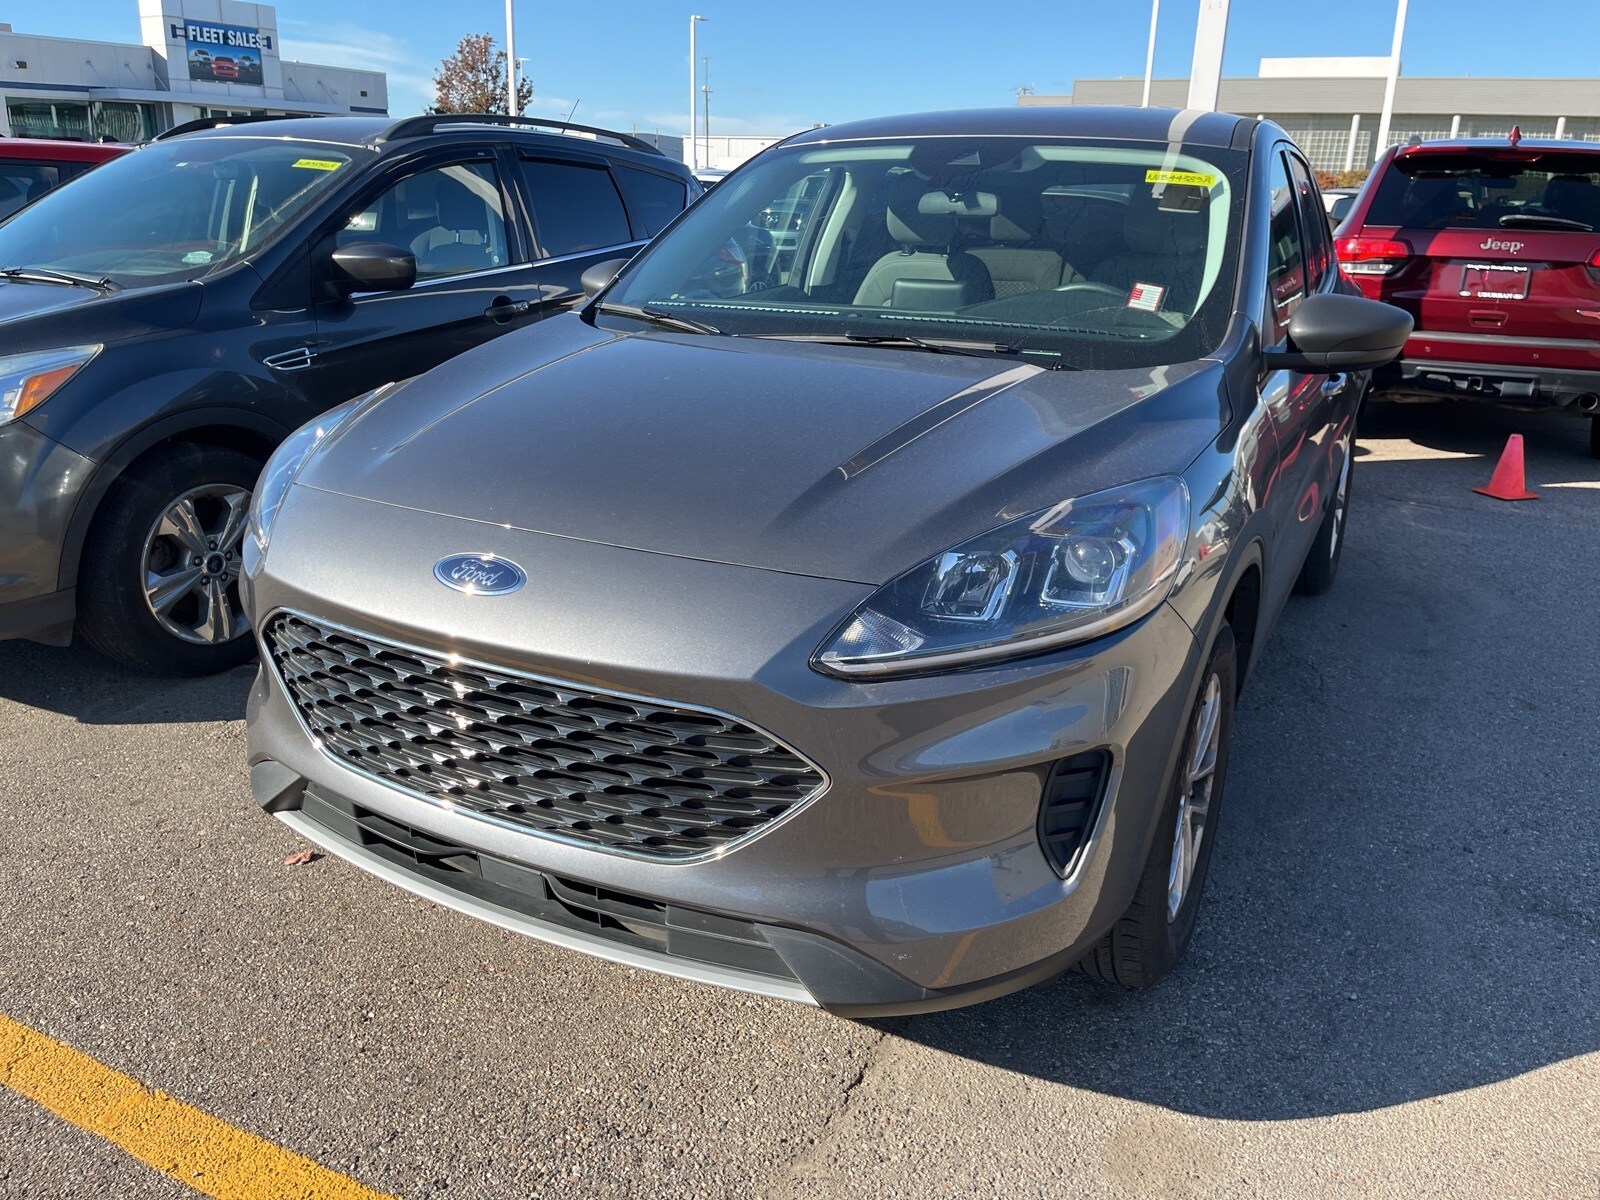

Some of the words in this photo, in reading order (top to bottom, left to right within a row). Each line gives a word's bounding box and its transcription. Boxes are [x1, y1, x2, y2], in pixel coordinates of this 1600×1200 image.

[187, 25, 224, 45] FLEET
[227, 30, 262, 49] SALES
[1480, 238, 1521, 253] Jeep
[451, 559, 504, 586] Ford
